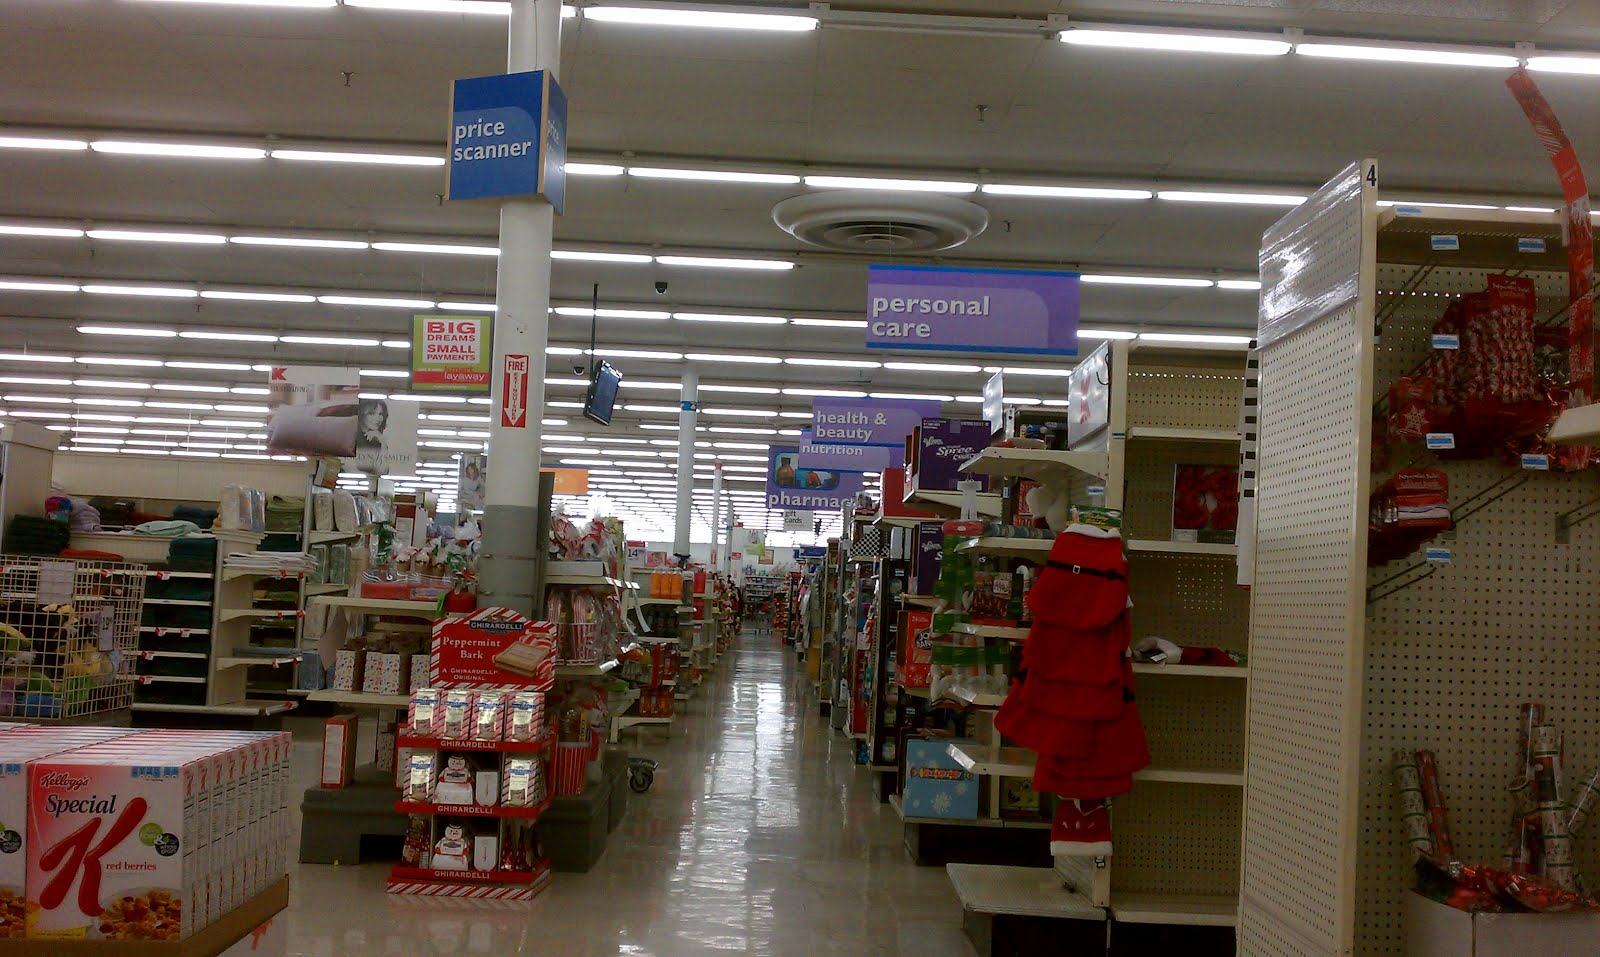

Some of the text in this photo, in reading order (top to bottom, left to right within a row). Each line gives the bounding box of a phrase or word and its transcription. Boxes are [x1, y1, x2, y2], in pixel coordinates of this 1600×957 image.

[455, 117, 505, 145] price
[454, 141, 532, 162] scanner
[1366, 164, 1377, 187] 4
[872, 295, 991, 317] personal
[427, 321, 476, 334] BIG
[871, 321, 931, 338] care
[427, 334, 476, 342] DREAMS
[427, 344, 476, 354] SMALL
[508, 361, 525, 371] FIRE
[444, 372, 485, 382] layaway
[816, 410, 887, 426] health &
[816, 425, 873, 442] beauty
[802, 443, 863, 456] nutrition
[470, 622, 523, 630] GHIRARDELLI
[443, 636, 501, 648] Peppermint
[460, 650, 484, 659] Bark
[440, 740, 496, 749] GHIRARDELLI
[40, 772, 90, 790] Kellogg's
[45, 794, 117, 818] Special
[437, 805, 493, 814] GHIRARDELLI
[39, 796, 148, 917] K
[106, 861, 157, 871] red berries
[434, 870, 490, 879] GHIRARDELLI
